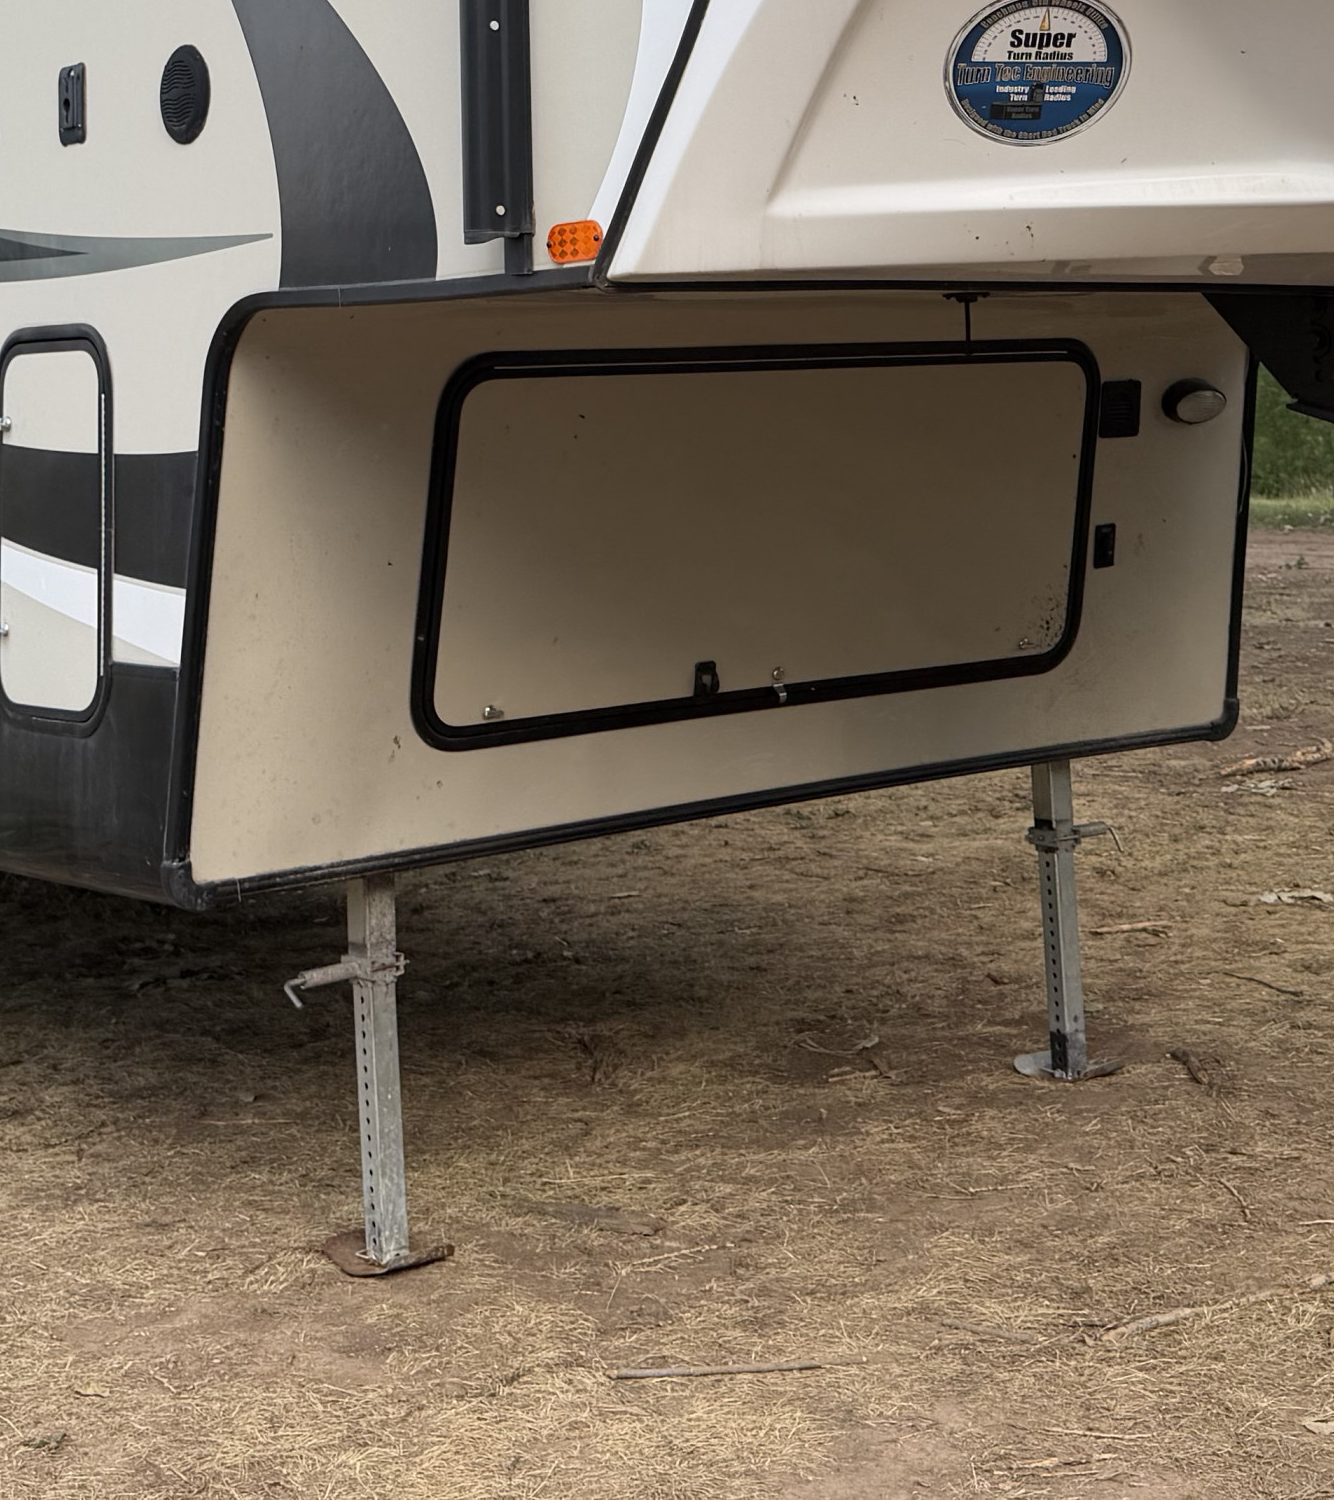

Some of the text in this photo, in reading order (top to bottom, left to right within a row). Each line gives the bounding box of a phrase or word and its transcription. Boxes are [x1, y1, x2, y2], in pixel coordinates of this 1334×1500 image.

[1009, 28, 1077, 50] Super
[1007, 50, 1074, 61] Turn Radius
[957, 62, 992, 86] Turn
[1023, 62, 1115, 88] Engineering
[996, 84, 1077, 94] Industry Leading
[1009, 93, 1072, 102] Turn Radius
